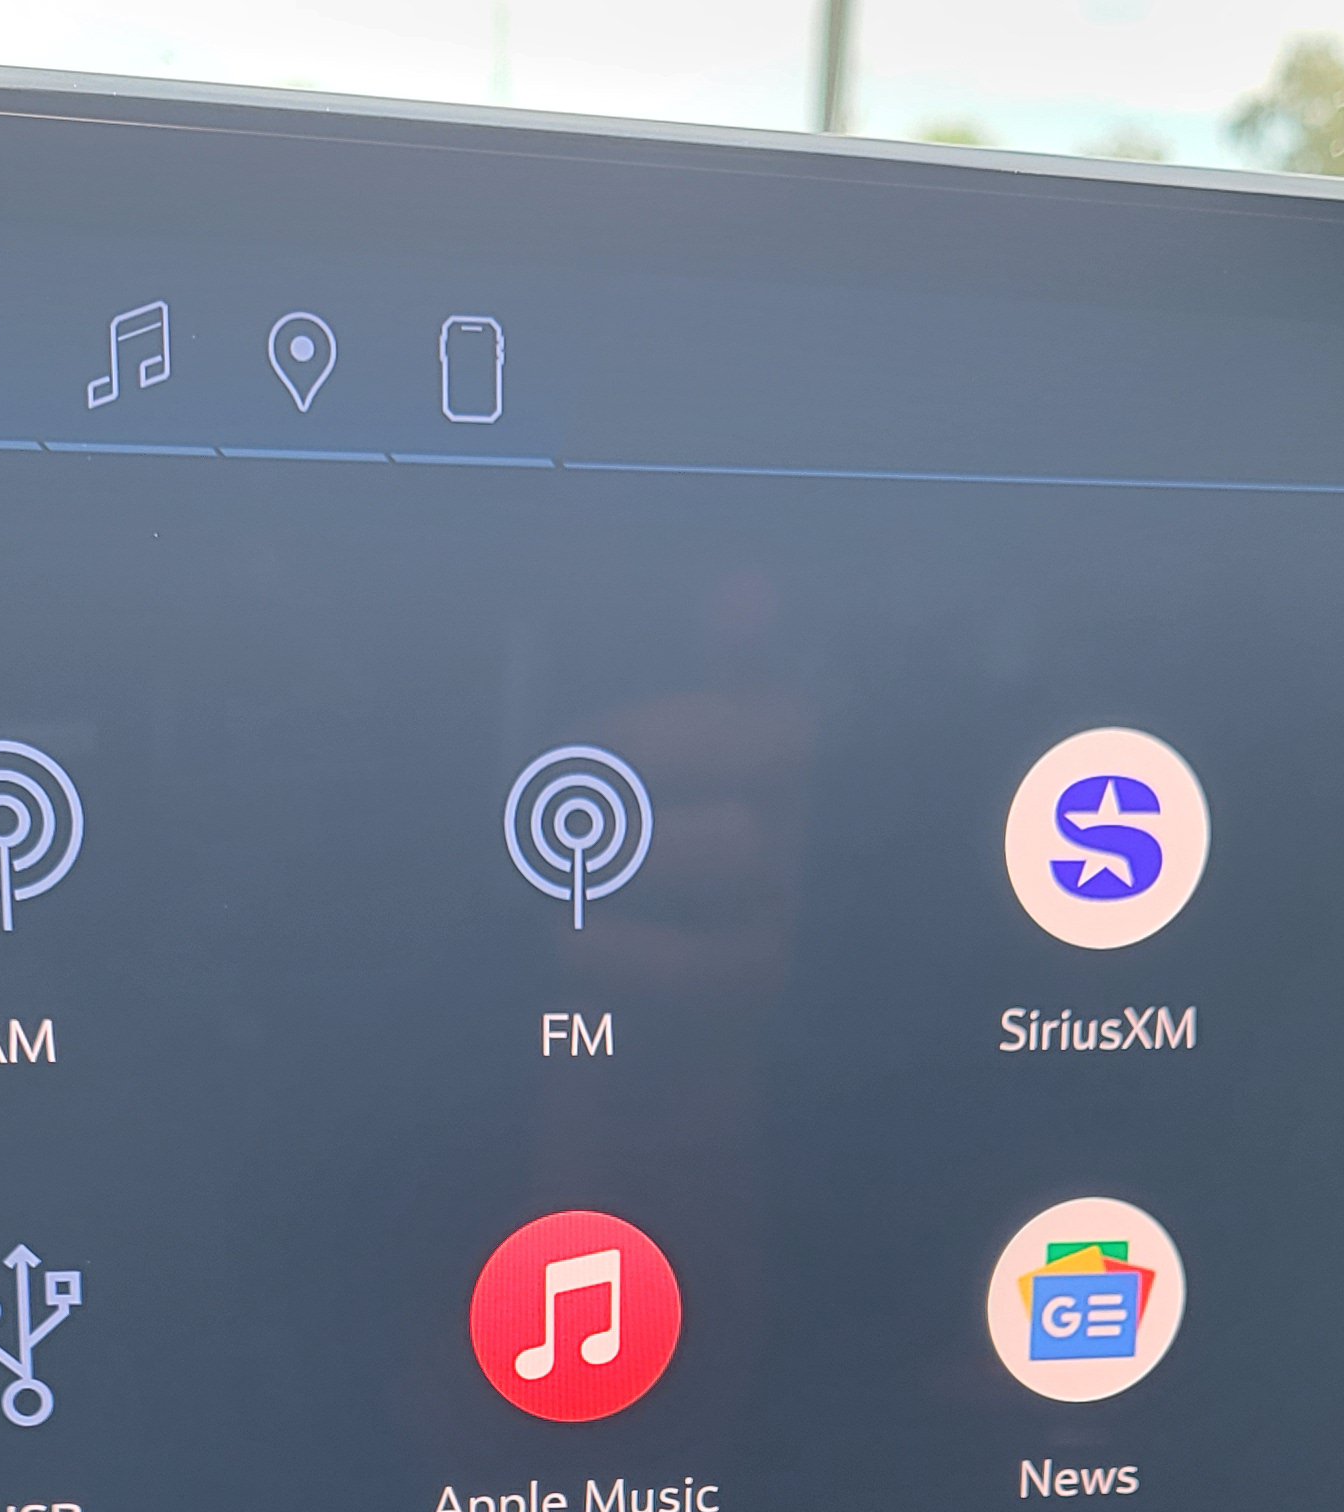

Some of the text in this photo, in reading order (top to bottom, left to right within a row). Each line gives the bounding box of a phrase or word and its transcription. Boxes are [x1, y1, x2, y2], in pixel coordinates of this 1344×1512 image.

[541, 1012, 614, 1057] FM
[999, 1006, 1196, 1051] SiriusXM
[1020, 1458, 1139, 1499] News
